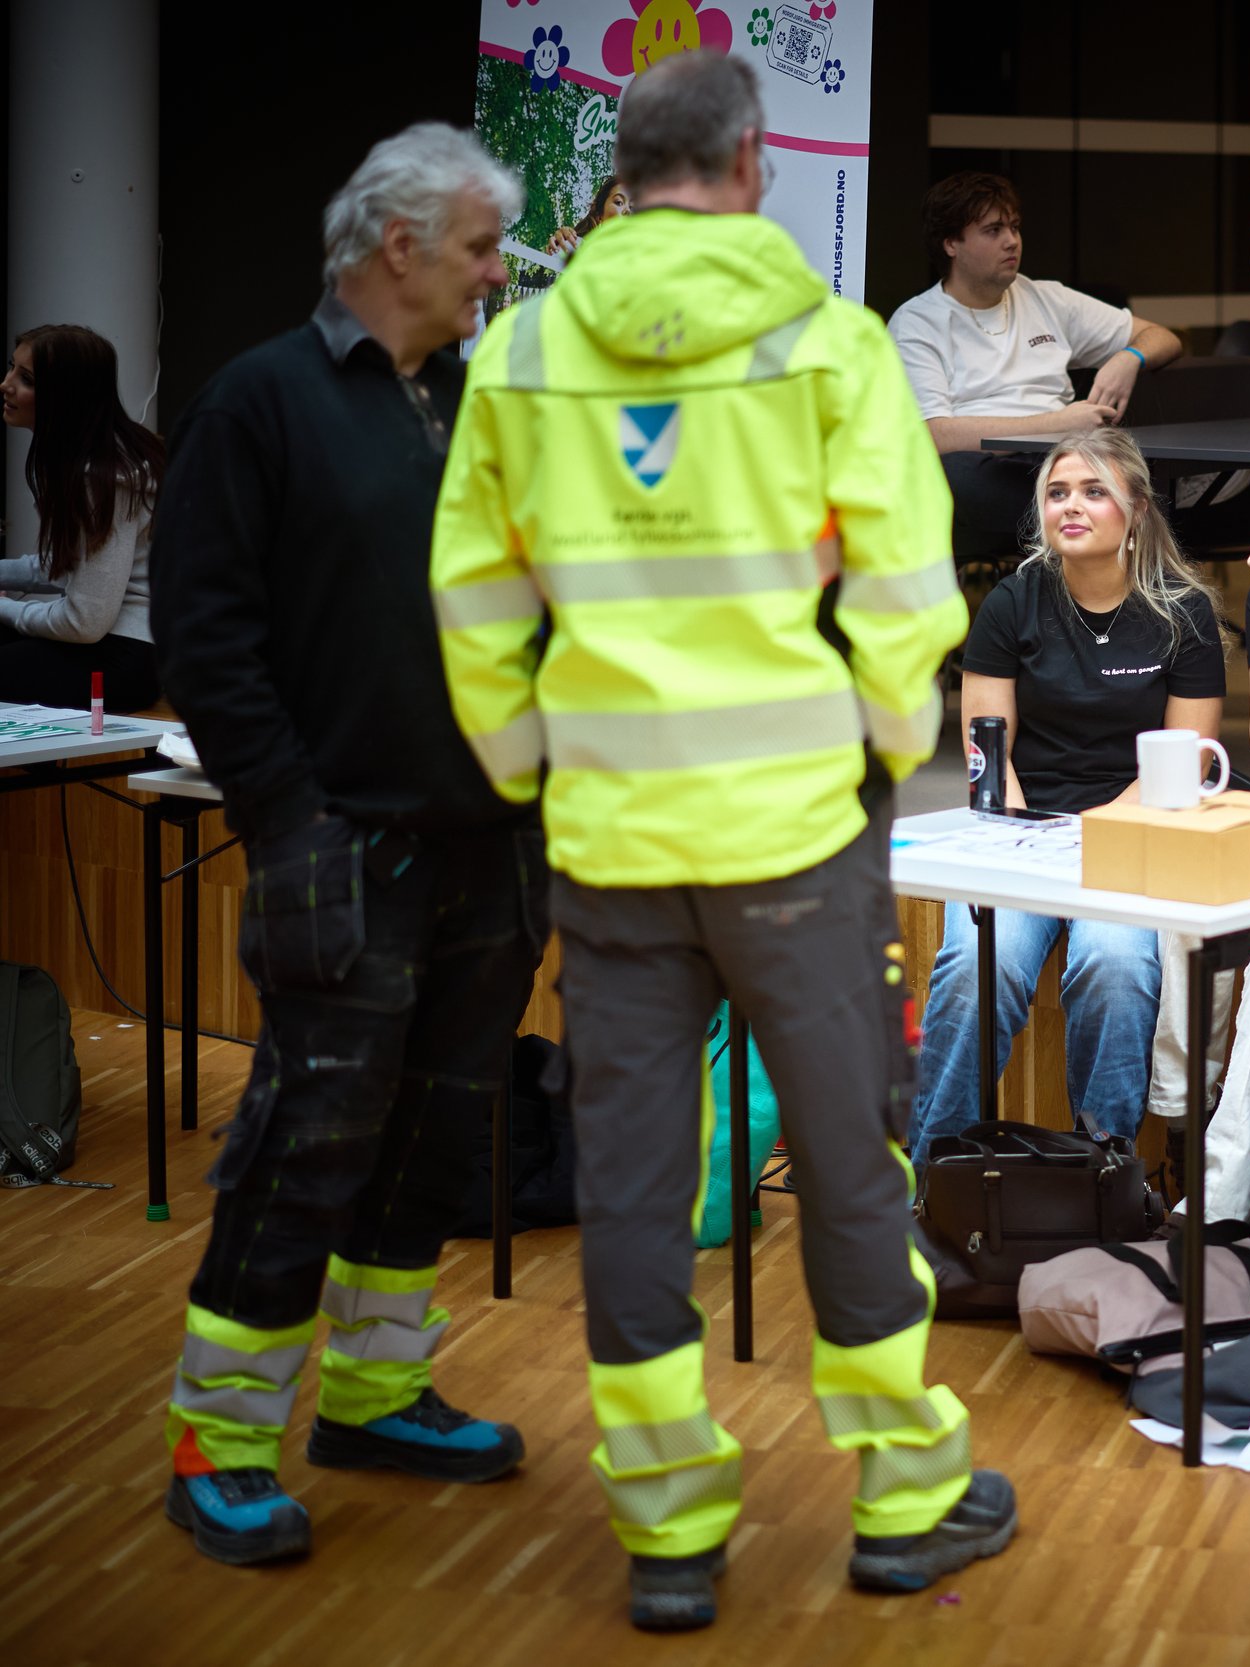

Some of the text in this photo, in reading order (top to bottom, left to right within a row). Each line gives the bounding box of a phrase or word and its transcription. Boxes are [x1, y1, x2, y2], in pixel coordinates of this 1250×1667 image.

[776, 61, 809, 79] SCAN FOR DETAILS
